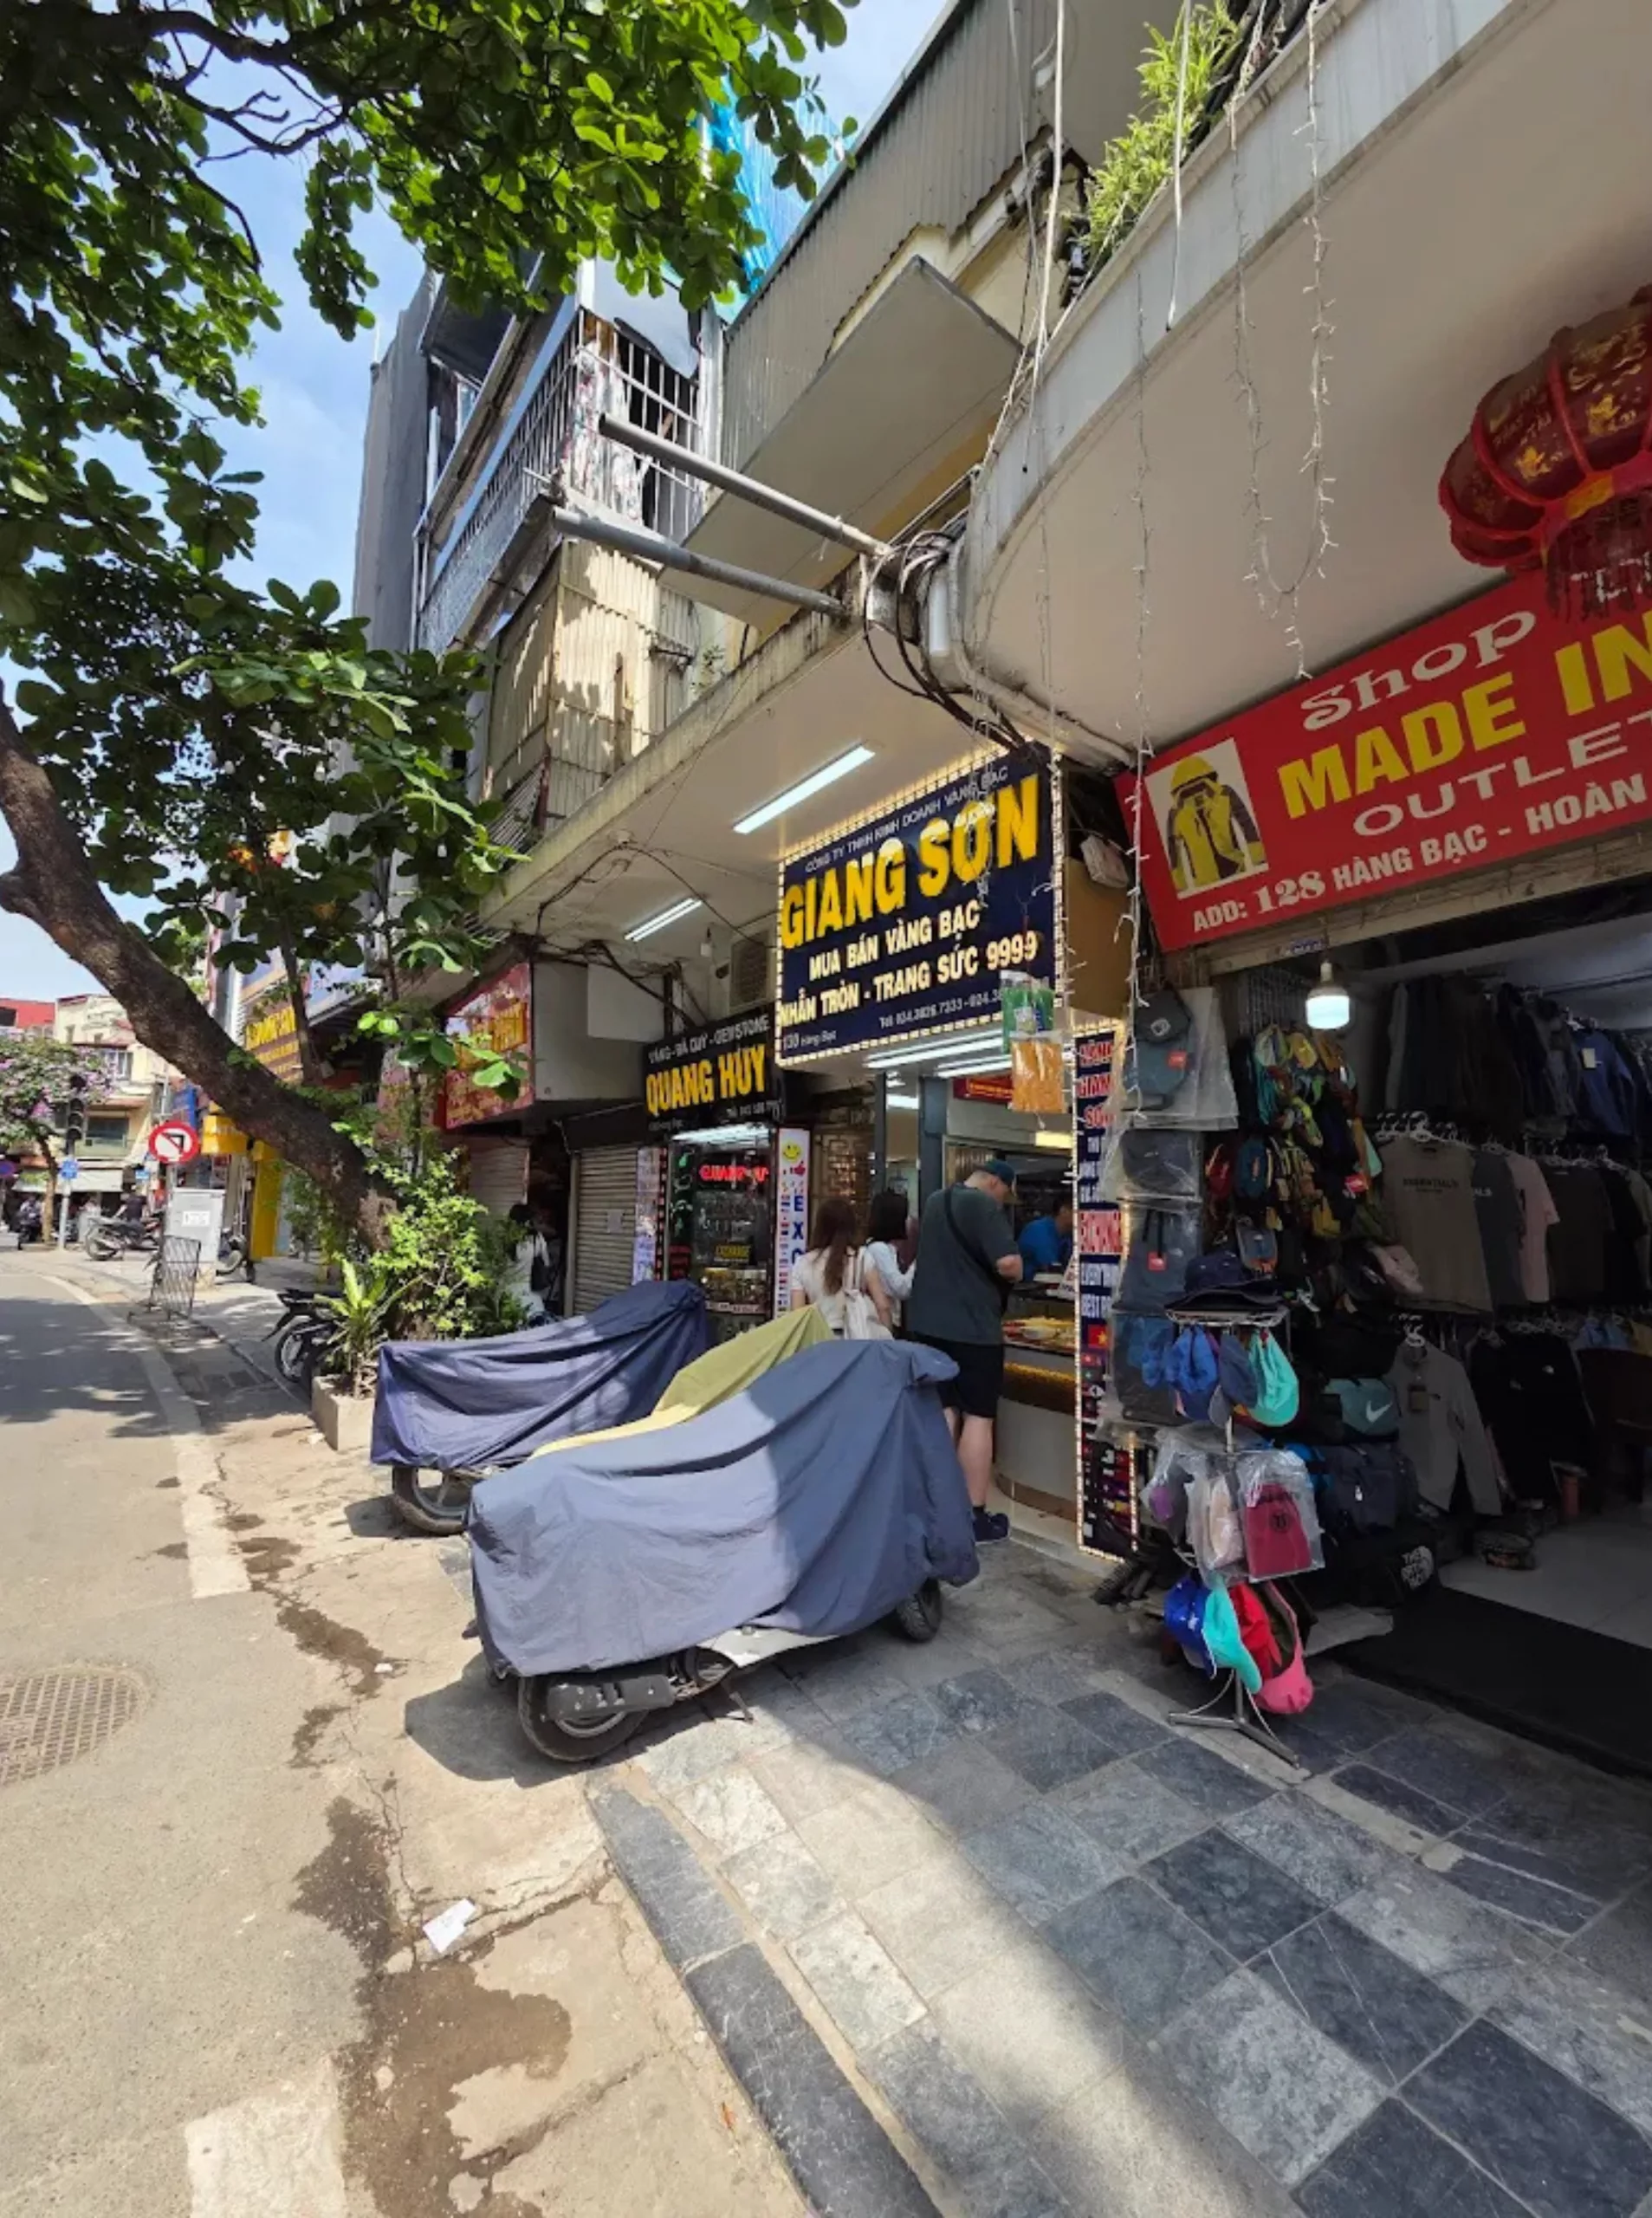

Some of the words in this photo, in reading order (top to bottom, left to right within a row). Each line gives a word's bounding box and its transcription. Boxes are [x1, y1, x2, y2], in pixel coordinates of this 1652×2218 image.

[1277, 671, 1526, 819] MADE
[1554, 609, 1652, 717] IN
[1300, 611, 1537, 731] Shop
[781, 836, 906, 950] GIANG
[917, 774, 1040, 898] SƠN
[902, 799, 942, 827] DOANH
[1191, 898, 1249, 934] ADD:
[1254, 871, 1327, 915] 128
[1331, 845, 1414, 891] HÀNG
[1419, 824, 1488, 866] BẠC
[1524, 773, 1649, 836] HOÀN
[809, 952, 841, 982] MUA
[845, 934, 879, 970] BÁN
[885, 914, 934, 956] VÀNG
[938, 899, 981, 941] BẠC
[820, 978, 860, 1017] TRÒN
[873, 961, 931, 1002] TRANG
[936, 944, 980, 985] SỨC
[986, 930, 1040, 971] 9999
[645, 1058, 715, 1118] QUANG
[717, 1043, 766, 1099] HUY
